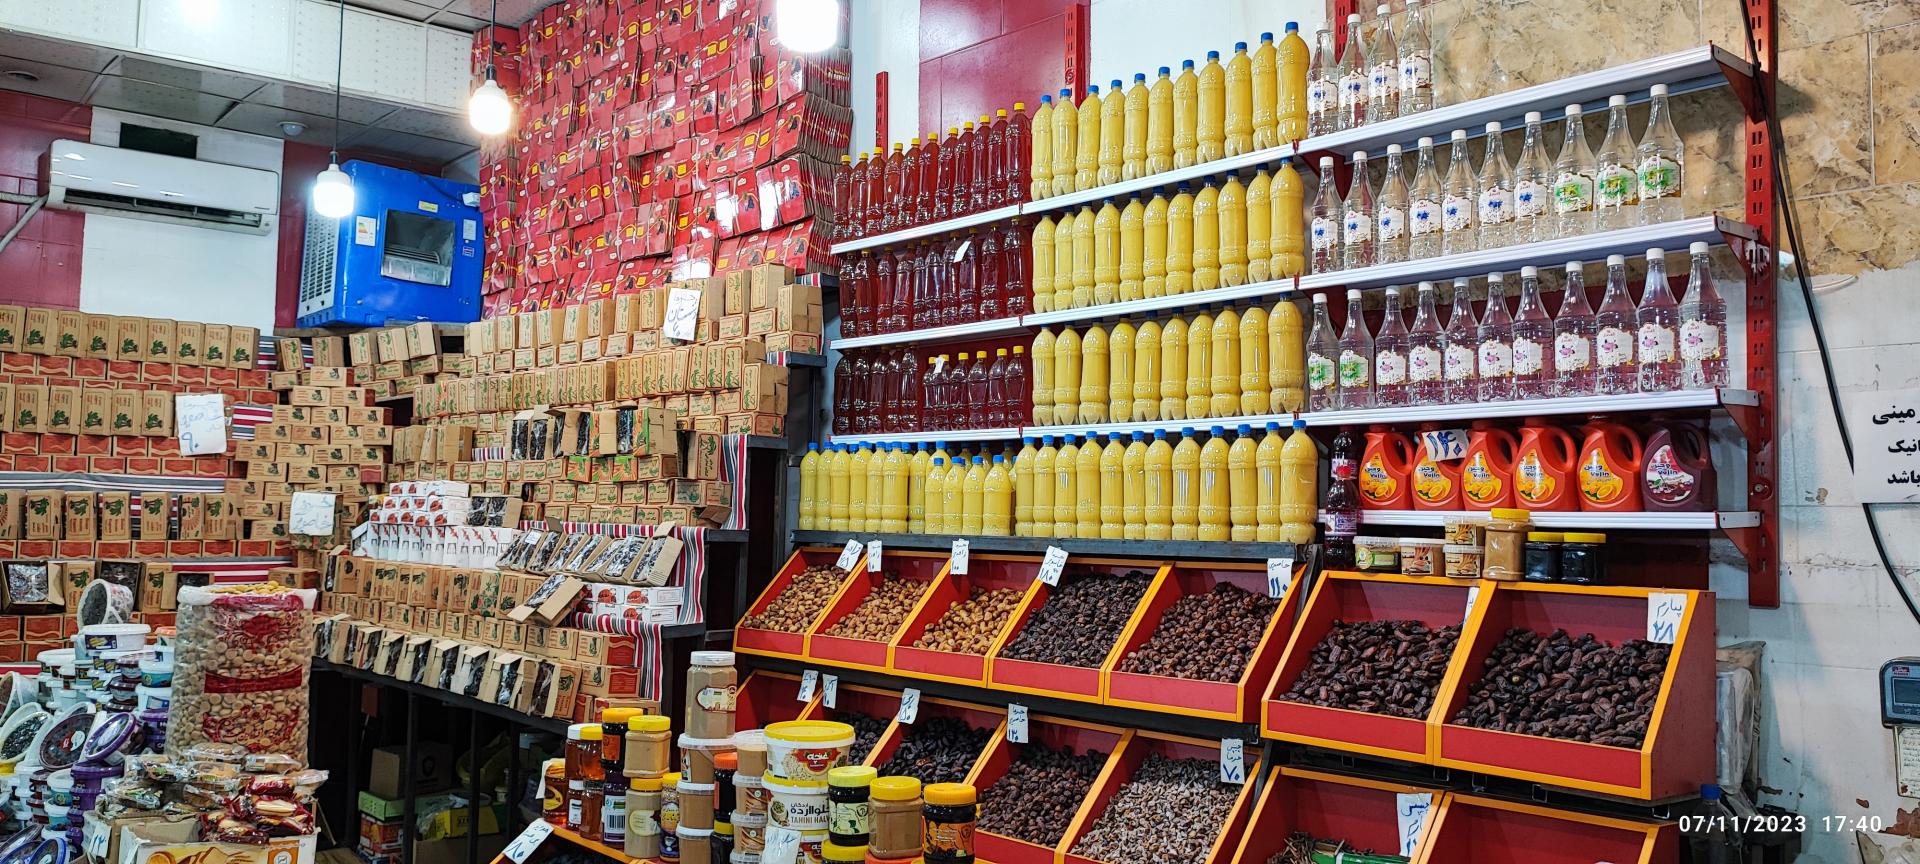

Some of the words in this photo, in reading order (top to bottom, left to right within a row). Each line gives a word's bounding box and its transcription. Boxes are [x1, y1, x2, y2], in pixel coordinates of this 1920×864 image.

[1872, 405, 1920, 425] مینی
[1427, 431, 1463, 459] ۱۴۰
[1656, 597, 1682, 618] پیارم
[1222, 763, 1240, 781] ۷۰
[791, 816, 813, 824] TAHINI
